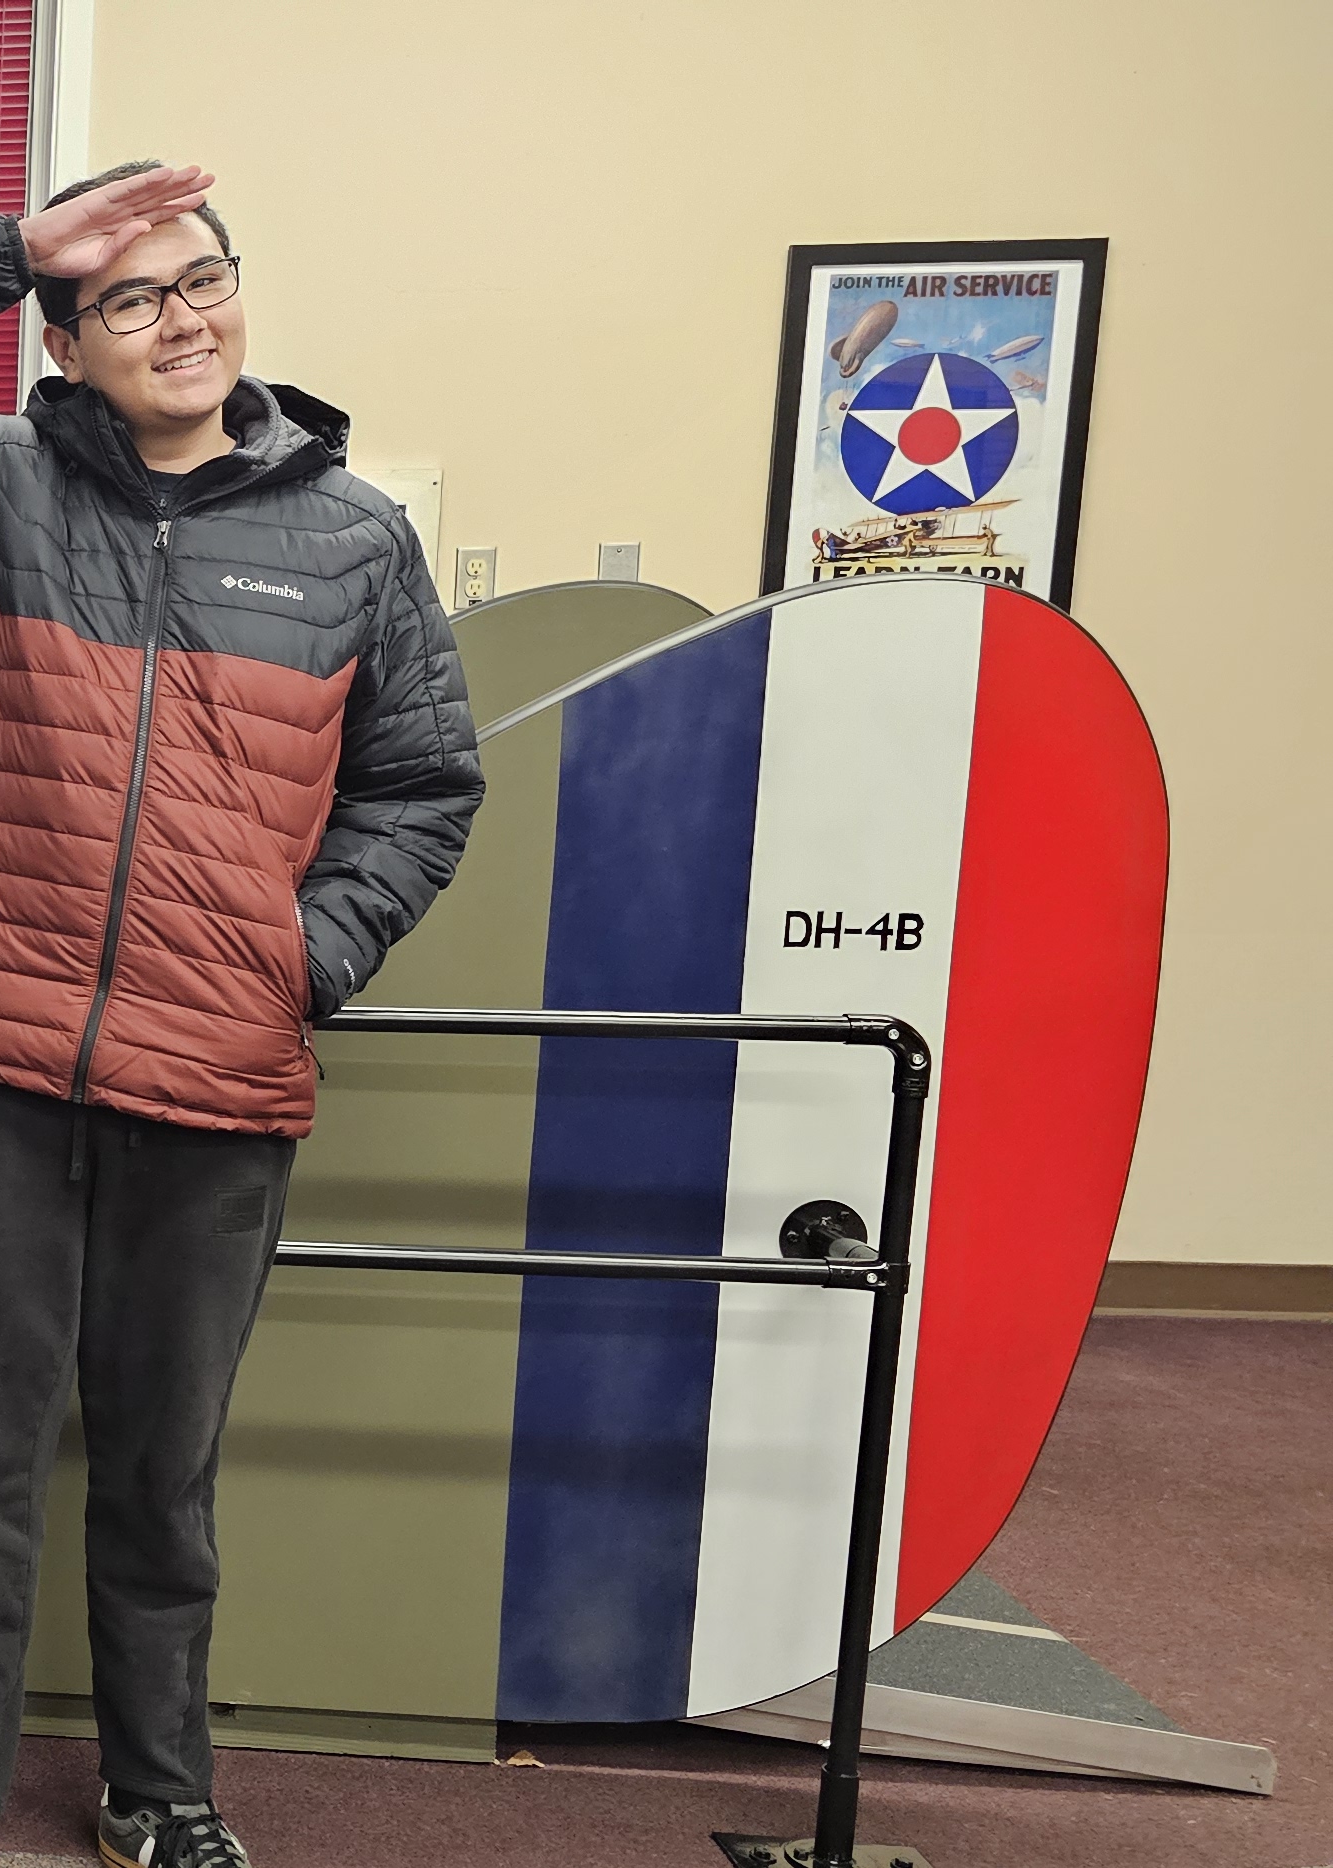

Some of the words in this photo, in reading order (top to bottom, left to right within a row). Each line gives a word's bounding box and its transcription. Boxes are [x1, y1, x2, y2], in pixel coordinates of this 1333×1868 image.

[832, 276, 872, 289] JOIN
[876, 275, 905, 289] THE
[903, 274, 947, 298] AIR
[953, 273, 1054, 297] SERVICE
[237, 577, 304, 601] Columbia
[783, 911, 924, 951] DH-4B
